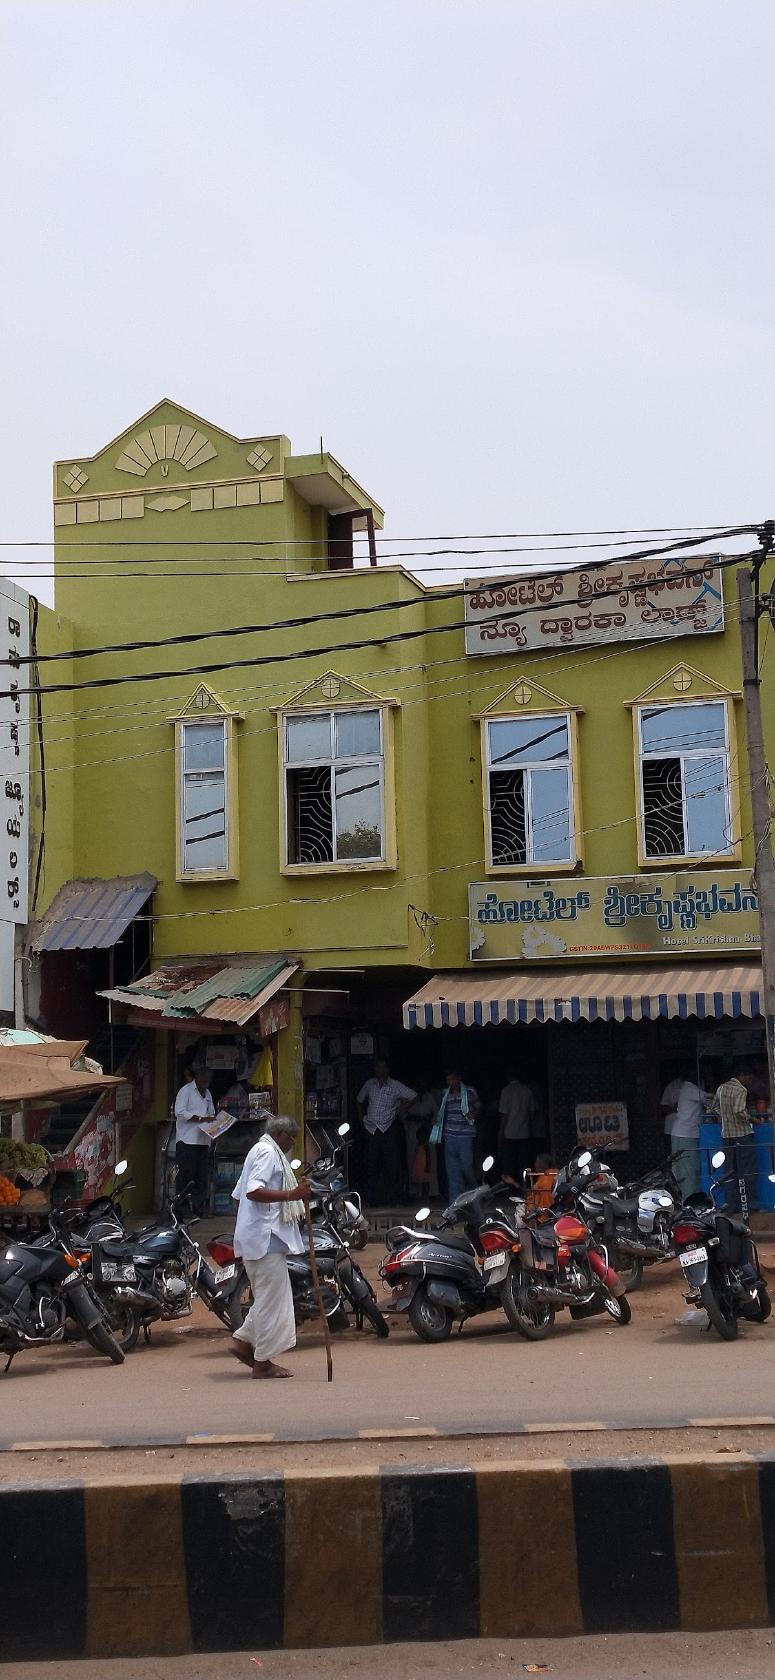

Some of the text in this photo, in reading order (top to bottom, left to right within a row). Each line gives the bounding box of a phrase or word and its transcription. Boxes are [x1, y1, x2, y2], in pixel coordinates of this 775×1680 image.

[469, 575, 564, 610] ಹೋಟೆಲ್
[479, 619, 527, 647] ನ್ಯೂ
[476, 882, 760, 932] ಹೋಟೆಲ್ ಶ್ರೀಕೃಷ್ಣಭವನ
[662, 936, 690, 946] Hotel
